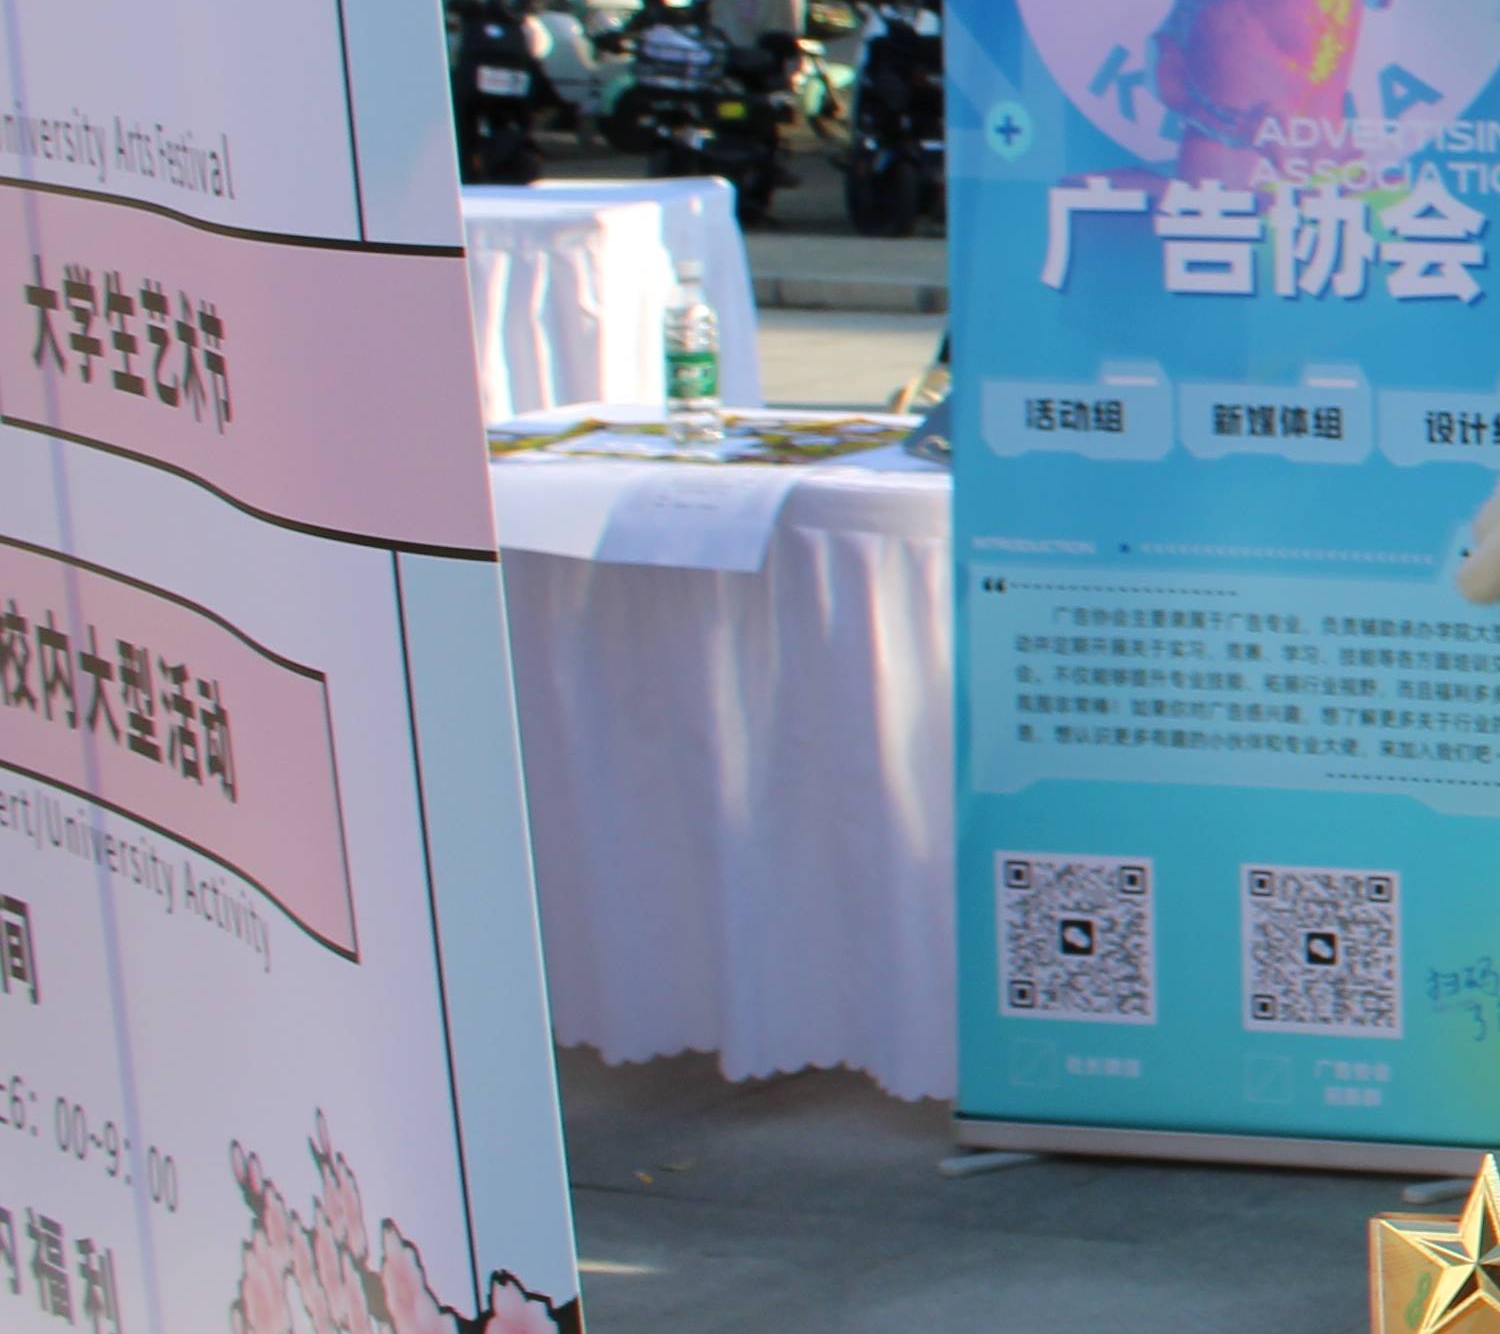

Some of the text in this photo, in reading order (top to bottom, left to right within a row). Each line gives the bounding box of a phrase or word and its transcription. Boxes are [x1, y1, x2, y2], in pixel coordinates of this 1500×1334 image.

[0, 101, 235, 200] niversity Arts Festival
[1040, 175, 1490, 304] 广告协会
[25, 254, 233, 436] 大学生艺术节
[1024, 397, 1126, 434] 活动组
[1211, 402, 1346, 442] 新媒体组
[0, 787, 271, 974] ert/University Activity
